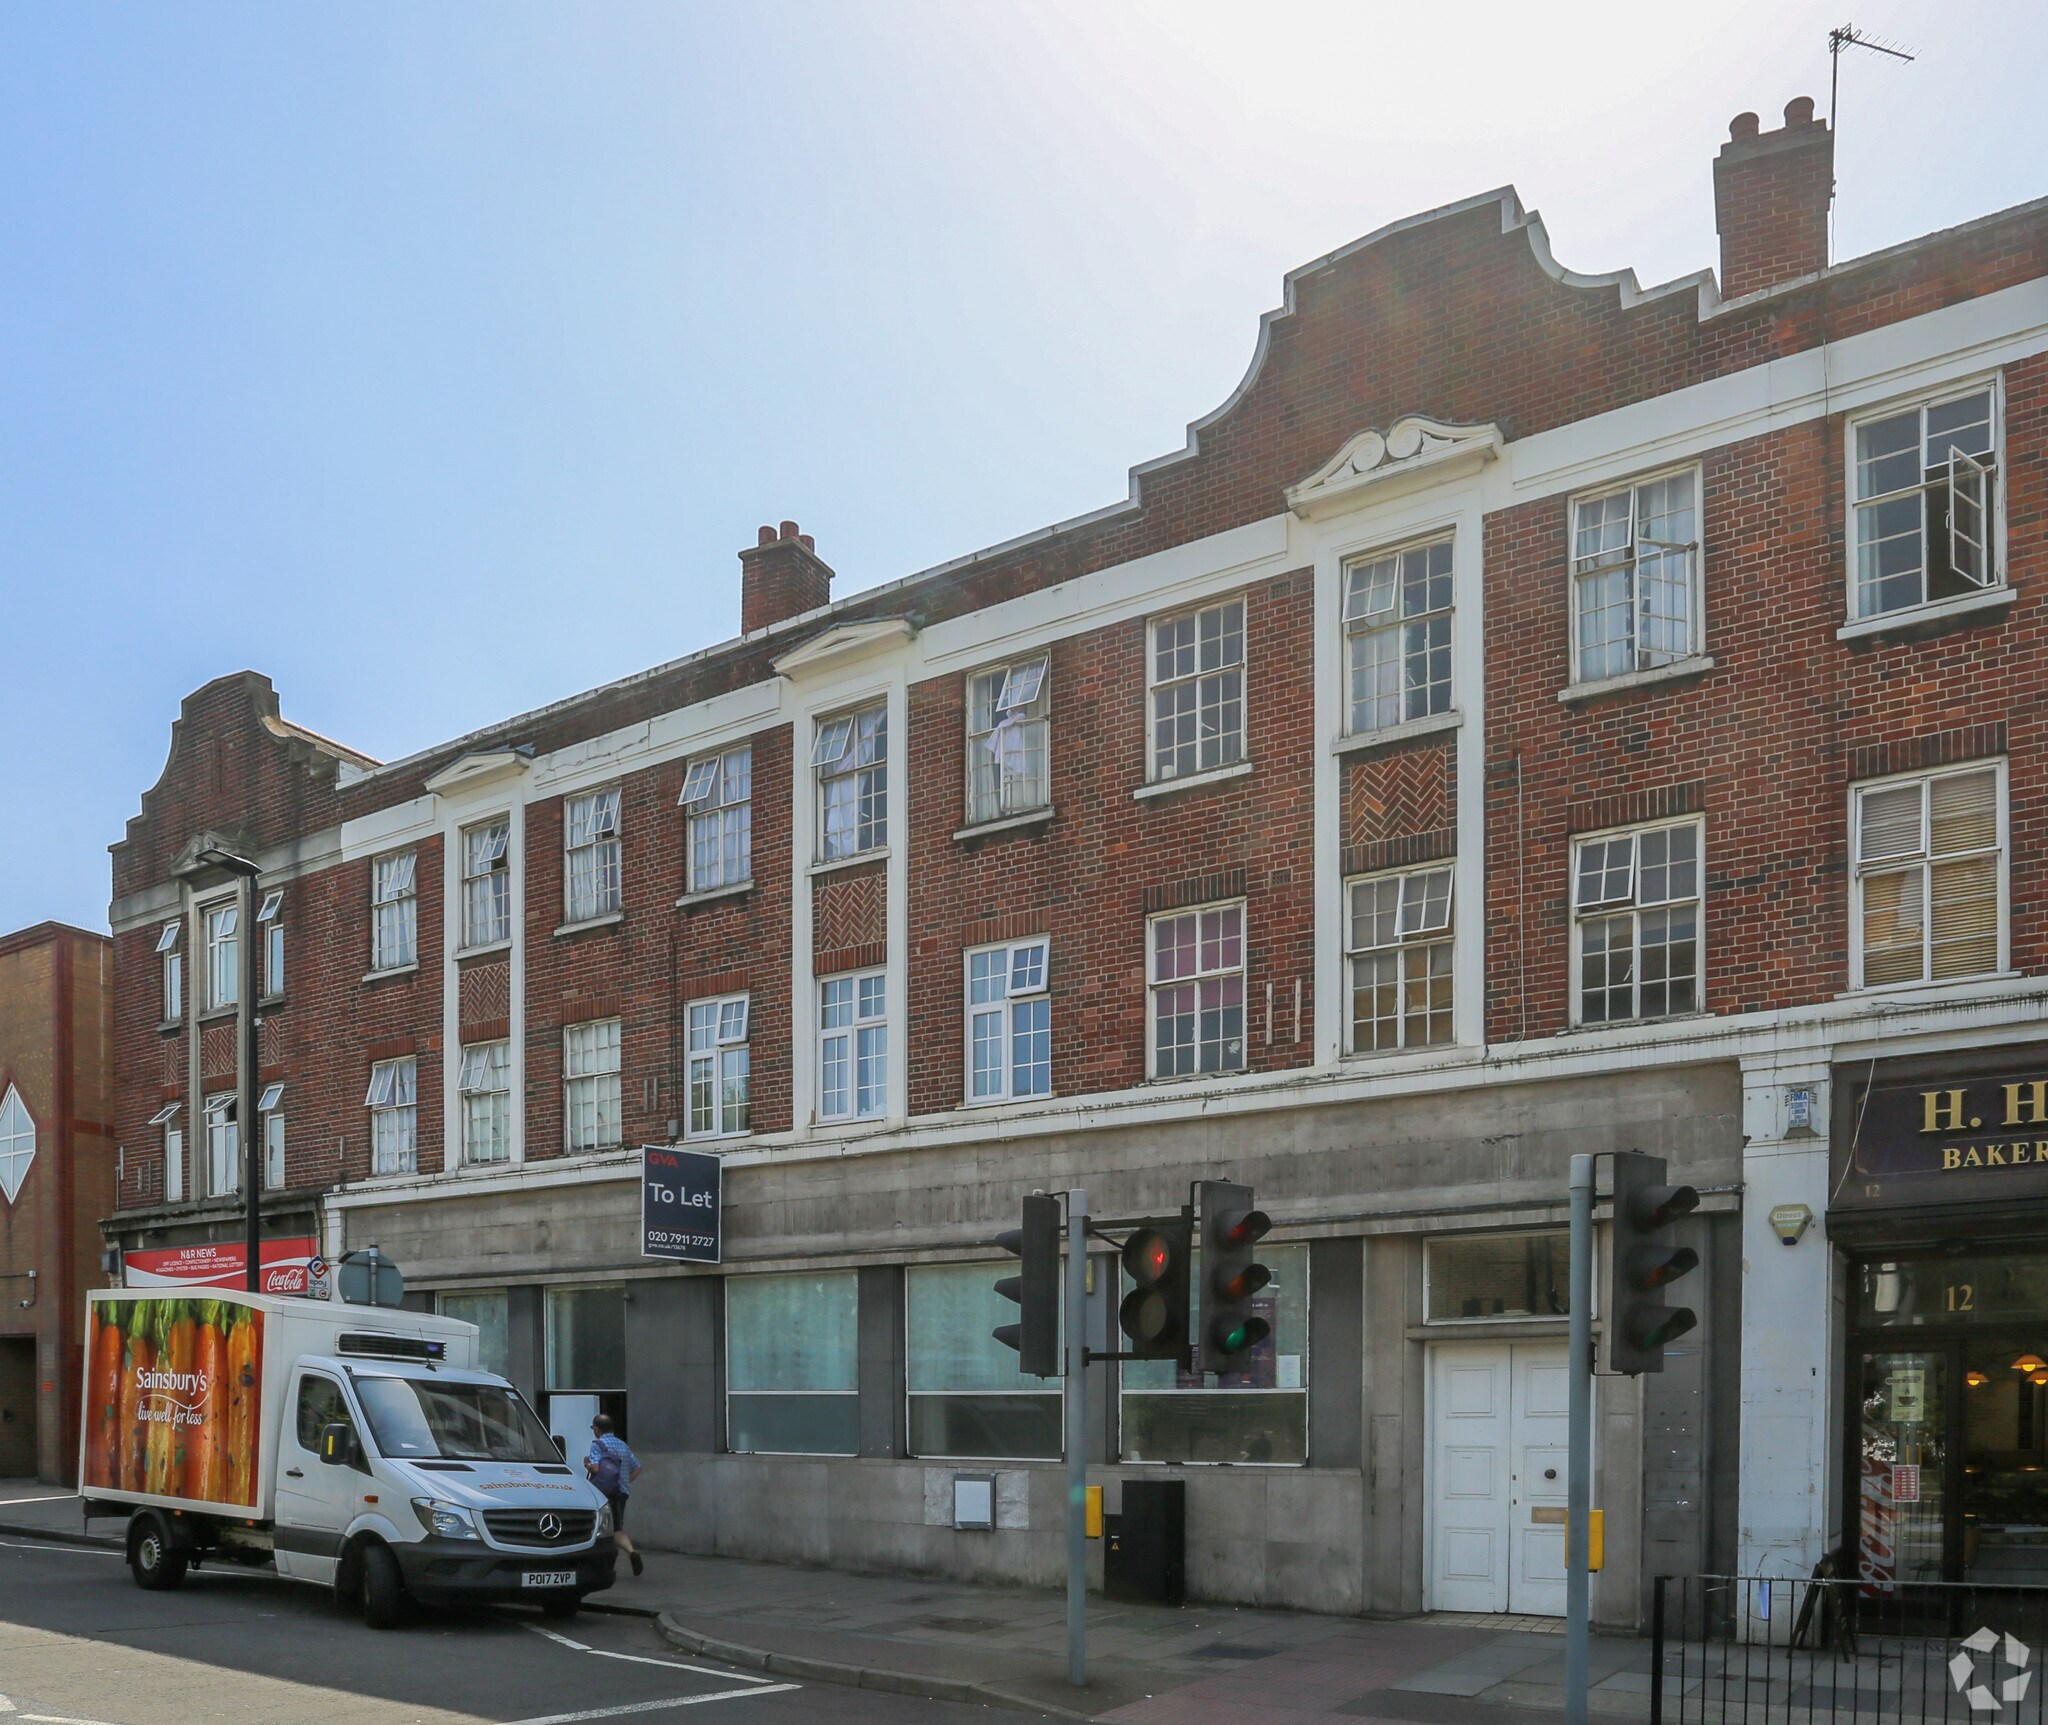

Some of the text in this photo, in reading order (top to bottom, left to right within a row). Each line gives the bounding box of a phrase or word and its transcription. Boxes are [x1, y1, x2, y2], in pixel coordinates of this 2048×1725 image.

[1790, 1092, 1808, 1101] RMA
[1919, 1088, 1982, 1133] H.
[648, 1151, 679, 1168] GVA
[648, 1182, 713, 1209] To Let
[1864, 1184, 1881, 1198] 12
[648, 1230, 715, 1247] 020 7911 2727
[180, 1247, 217, 1259] N&R NEWS
[1946, 1284, 1974, 1312] 12
[136, 1366, 207, 1397] Sainsbury's
[138, 1400, 202, 1431] live well for less
[479, 1481, 577, 1492] sainsburys.co.uk
[528, 1573, 571, 1585] PO17 ZVP
